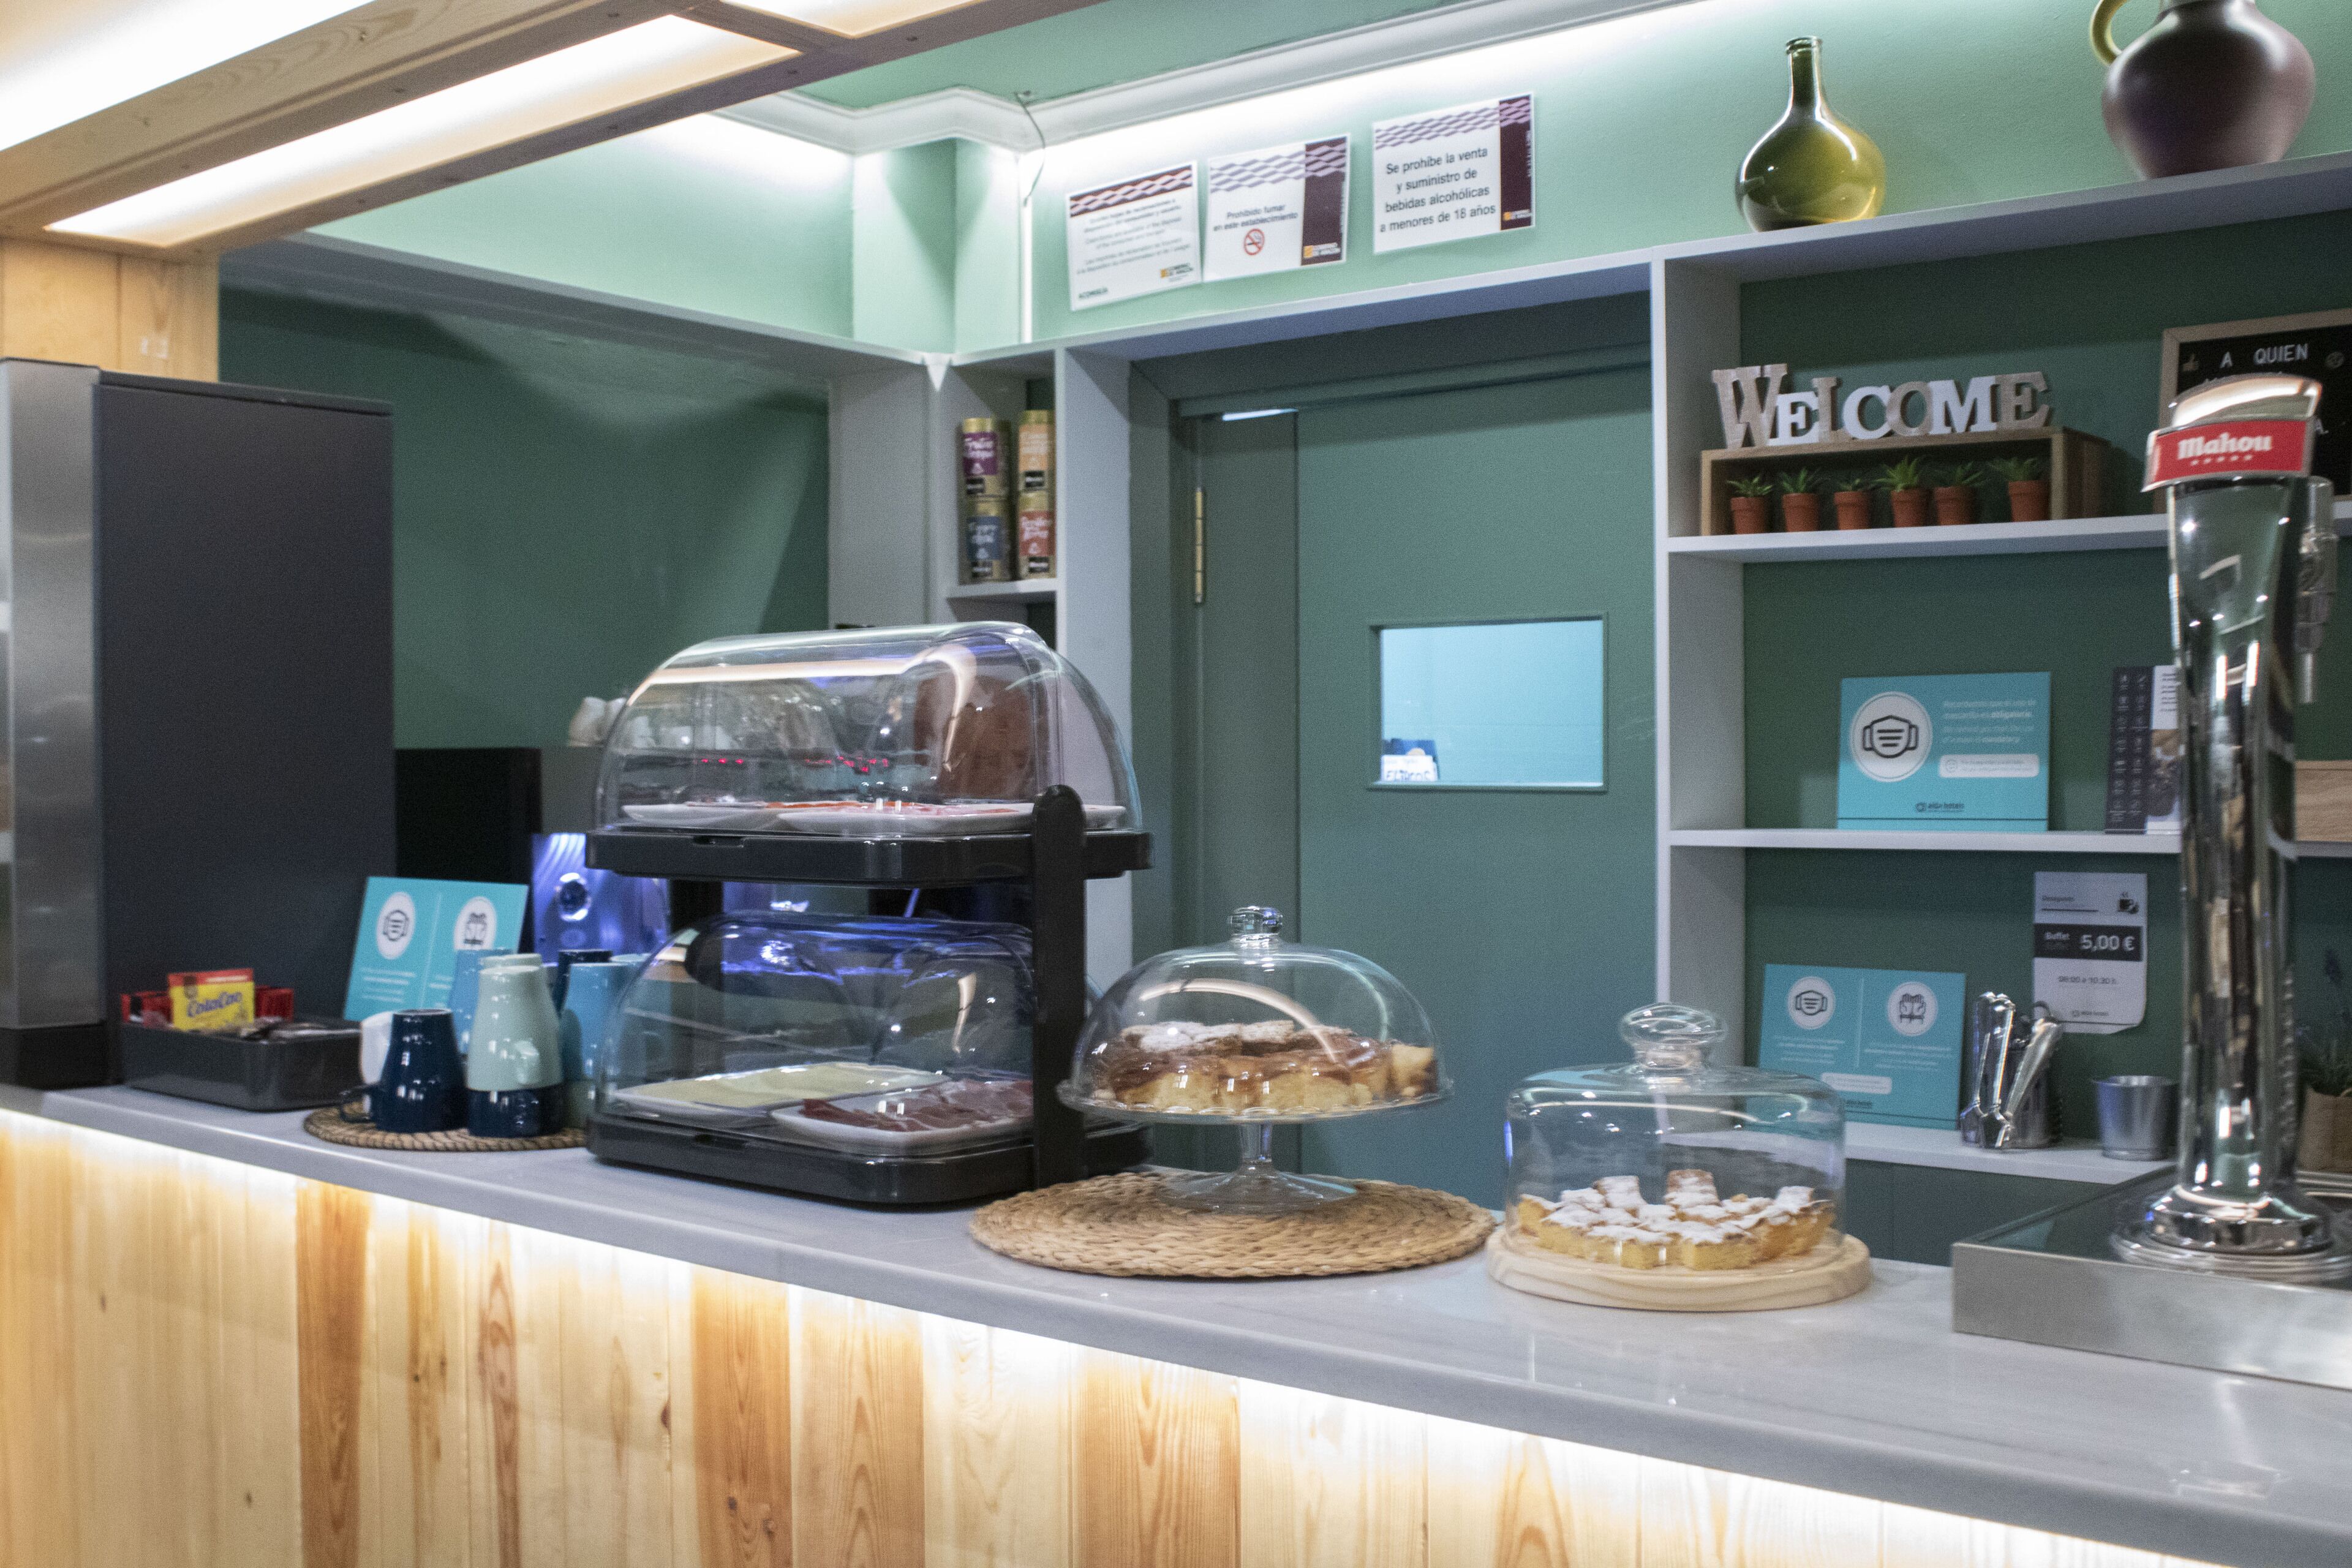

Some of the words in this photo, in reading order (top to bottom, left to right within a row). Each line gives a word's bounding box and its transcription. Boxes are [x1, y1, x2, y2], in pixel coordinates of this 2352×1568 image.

[1386, 163, 1399, 175] Se
[1446, 152, 1455, 164] la
[1458, 147, 1488, 161] venta
[1396, 183, 1402, 194] y
[1406, 172, 1461, 190] suministro
[1464, 168, 1477, 179] de
[1227, 206, 1261, 219] Prohibido
[1264, 205, 1286, 214] fumar
[1385, 197, 1426, 213] bebidas
[1430, 186, 1490, 205] alcohólicas
[1241, 212, 1298, 227] establecimiento
[1389, 216, 1434, 231] menores
[1438, 211, 1450, 222] de
[1470, 204, 1496, 217] años
[2219, 352, 2233, 368] A
[2253, 344, 2308, 365] QUIEN
[1712, 363, 2049, 450] WELCOME
[2177, 431, 2273, 460] Mahou
[2080, 934, 2120, 952] 5,00
[2123, 935, 2135, 951] €
